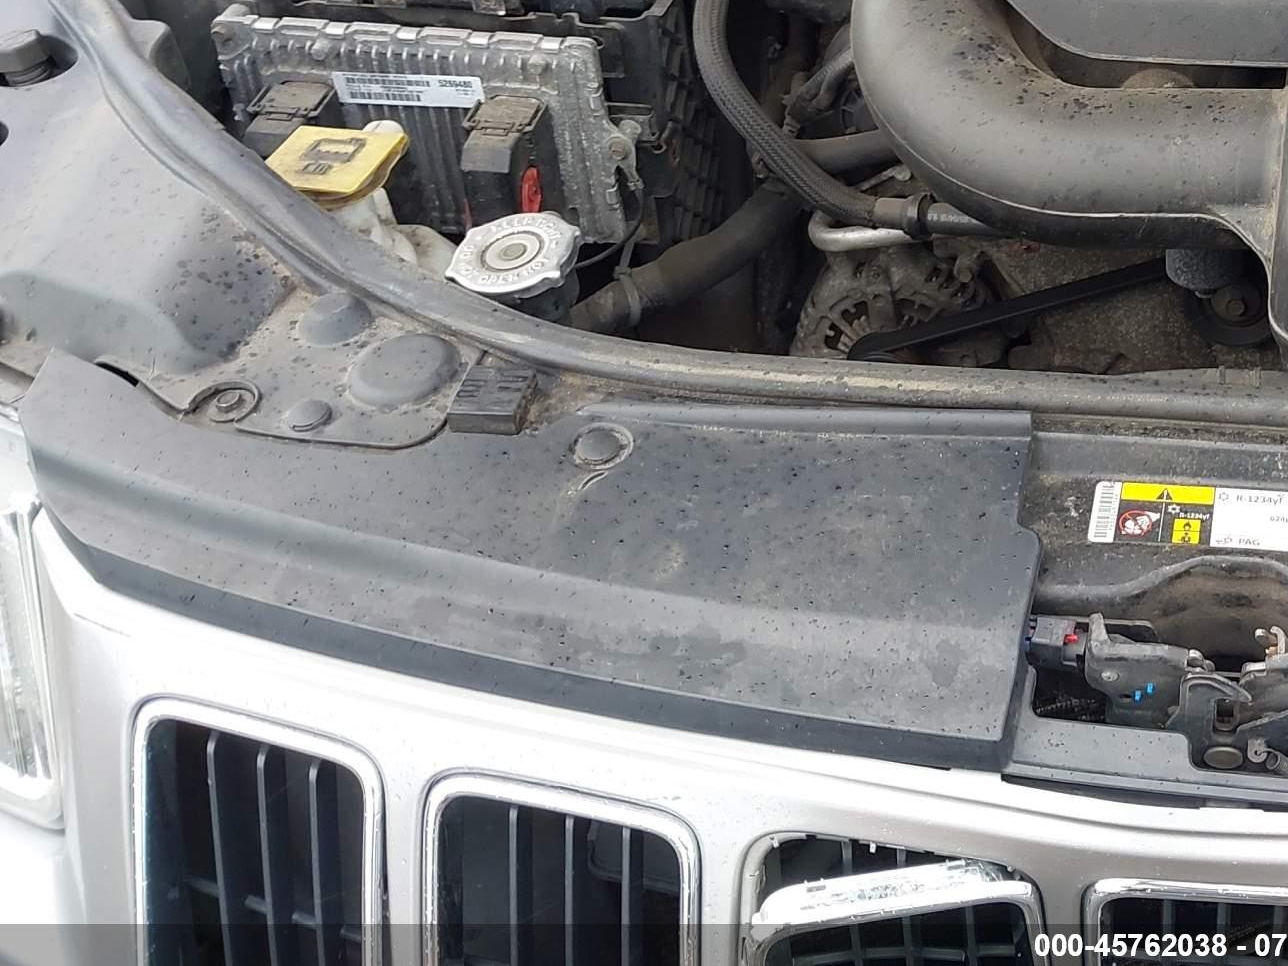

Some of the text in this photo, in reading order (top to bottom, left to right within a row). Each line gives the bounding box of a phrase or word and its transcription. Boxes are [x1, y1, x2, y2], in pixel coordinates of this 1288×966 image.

[479, 273, 521, 284] OPEN
[1236, 494, 1283, 505] R-1234yf
[1238, 538, 1261, 546] PAG
